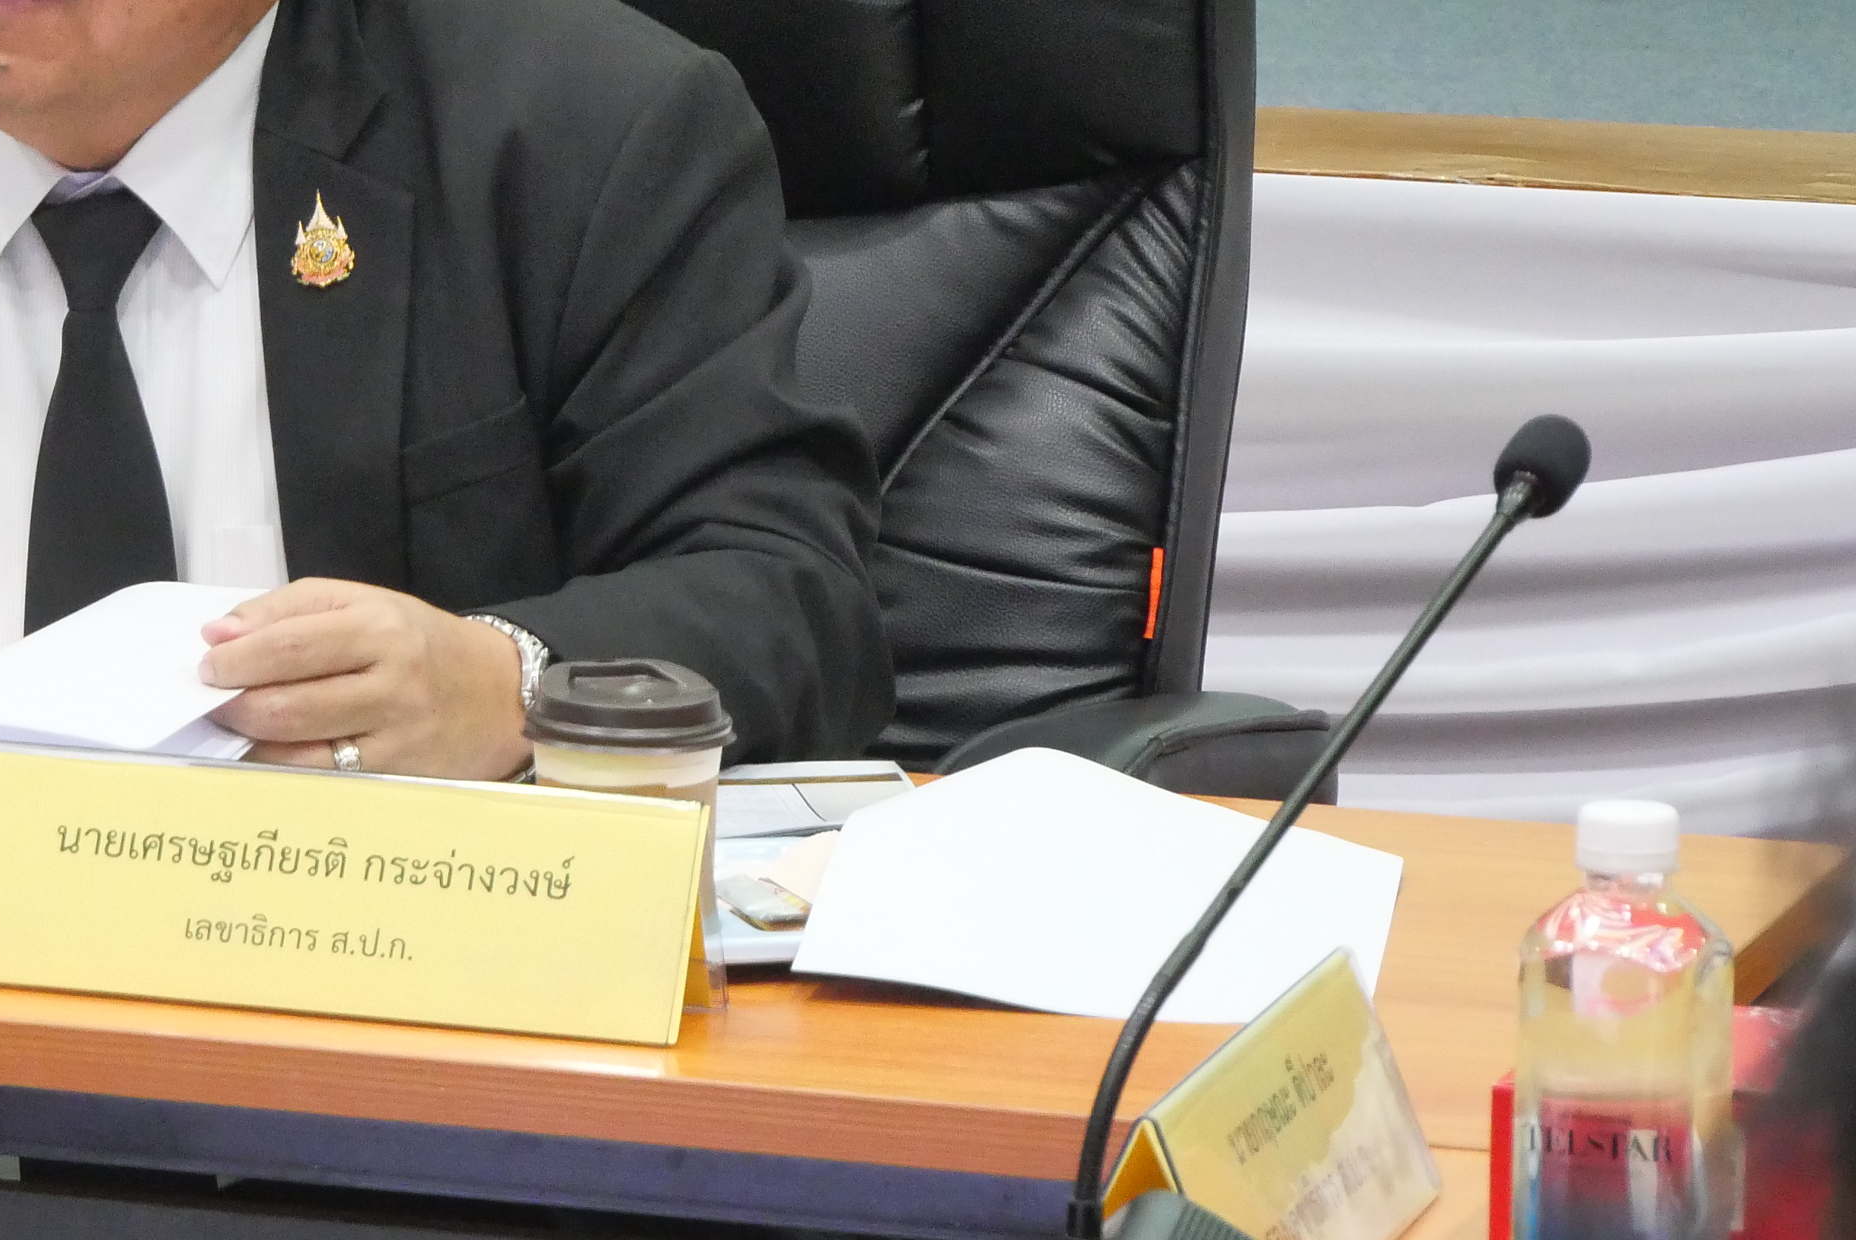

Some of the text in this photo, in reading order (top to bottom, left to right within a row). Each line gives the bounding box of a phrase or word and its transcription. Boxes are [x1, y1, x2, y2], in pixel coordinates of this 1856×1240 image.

[56, 824, 575, 900] นายเศรษฐเกียรติ กระจ่างวงษ์
[184, 913, 413, 961] เลขาธิการ ส.ป.ก.
